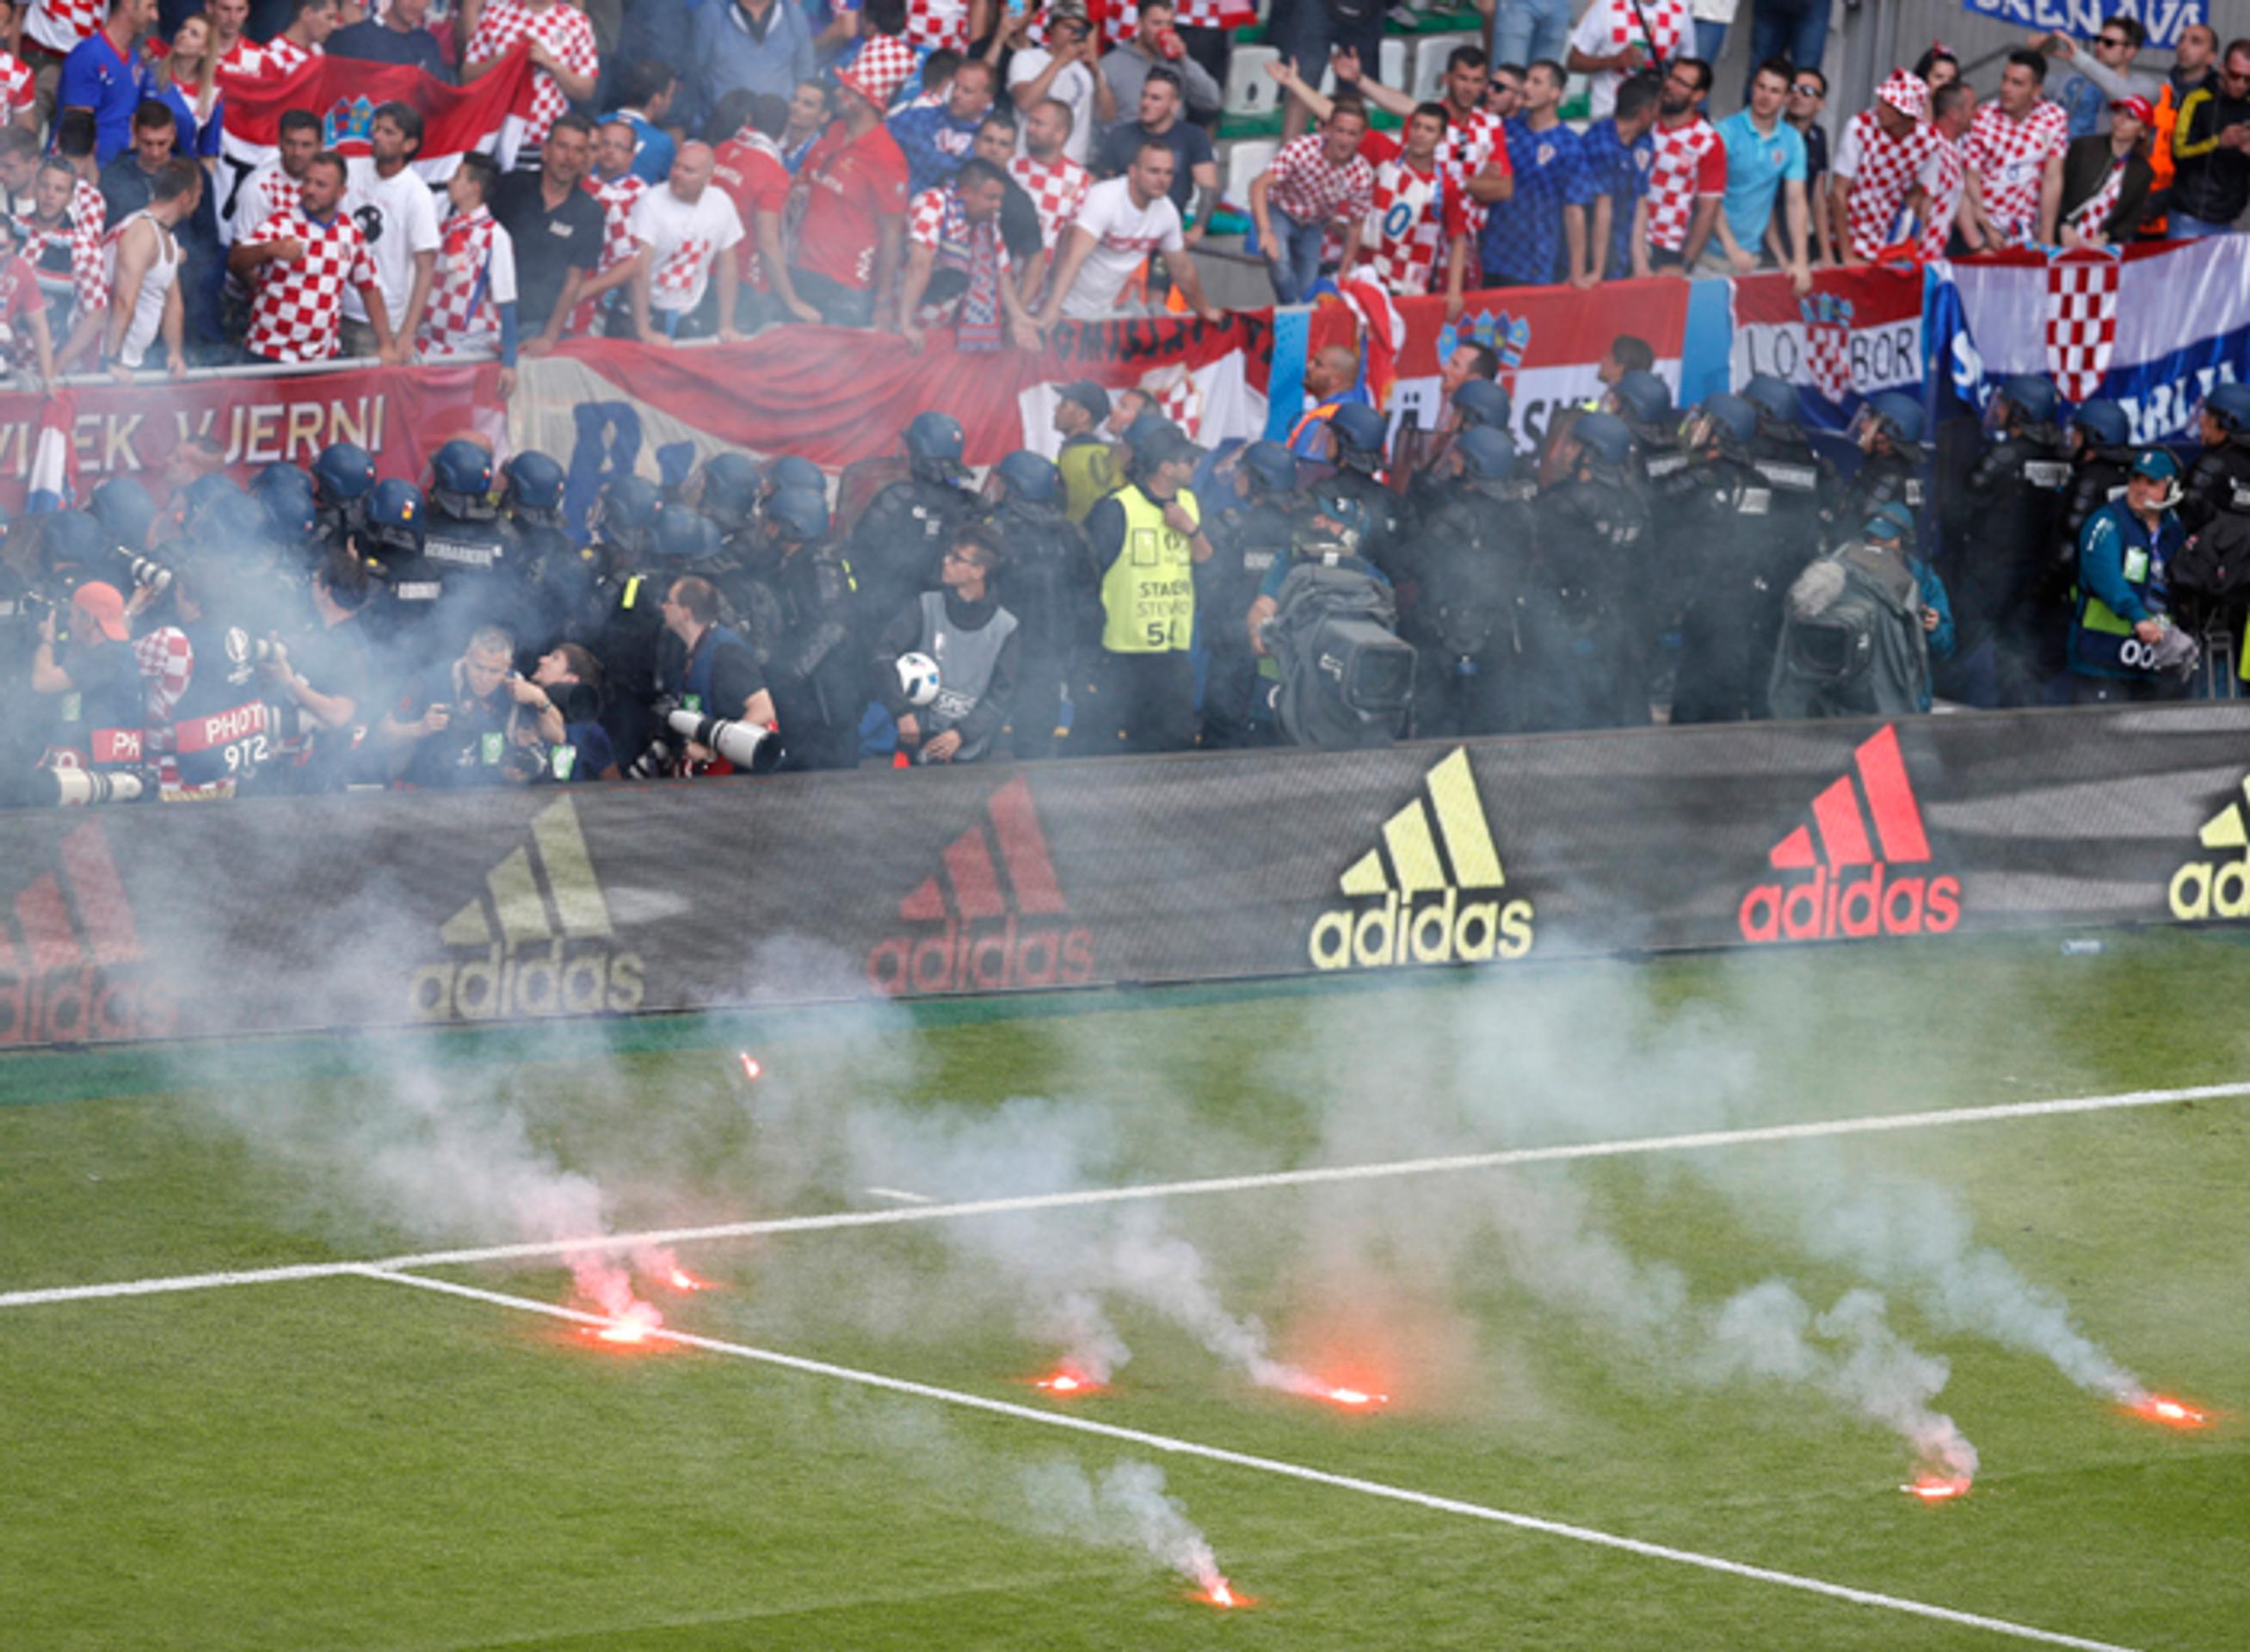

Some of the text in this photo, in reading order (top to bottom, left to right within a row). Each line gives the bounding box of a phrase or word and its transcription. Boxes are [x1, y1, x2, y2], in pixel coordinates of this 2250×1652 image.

[225, 735, 268, 772] 912
[1308, 886, 1534, 971] adidas
[1738, 861, 1961, 943] adidas
[408, 934, 645, 1020] adidas
[866, 914, 1095, 996] adidas
